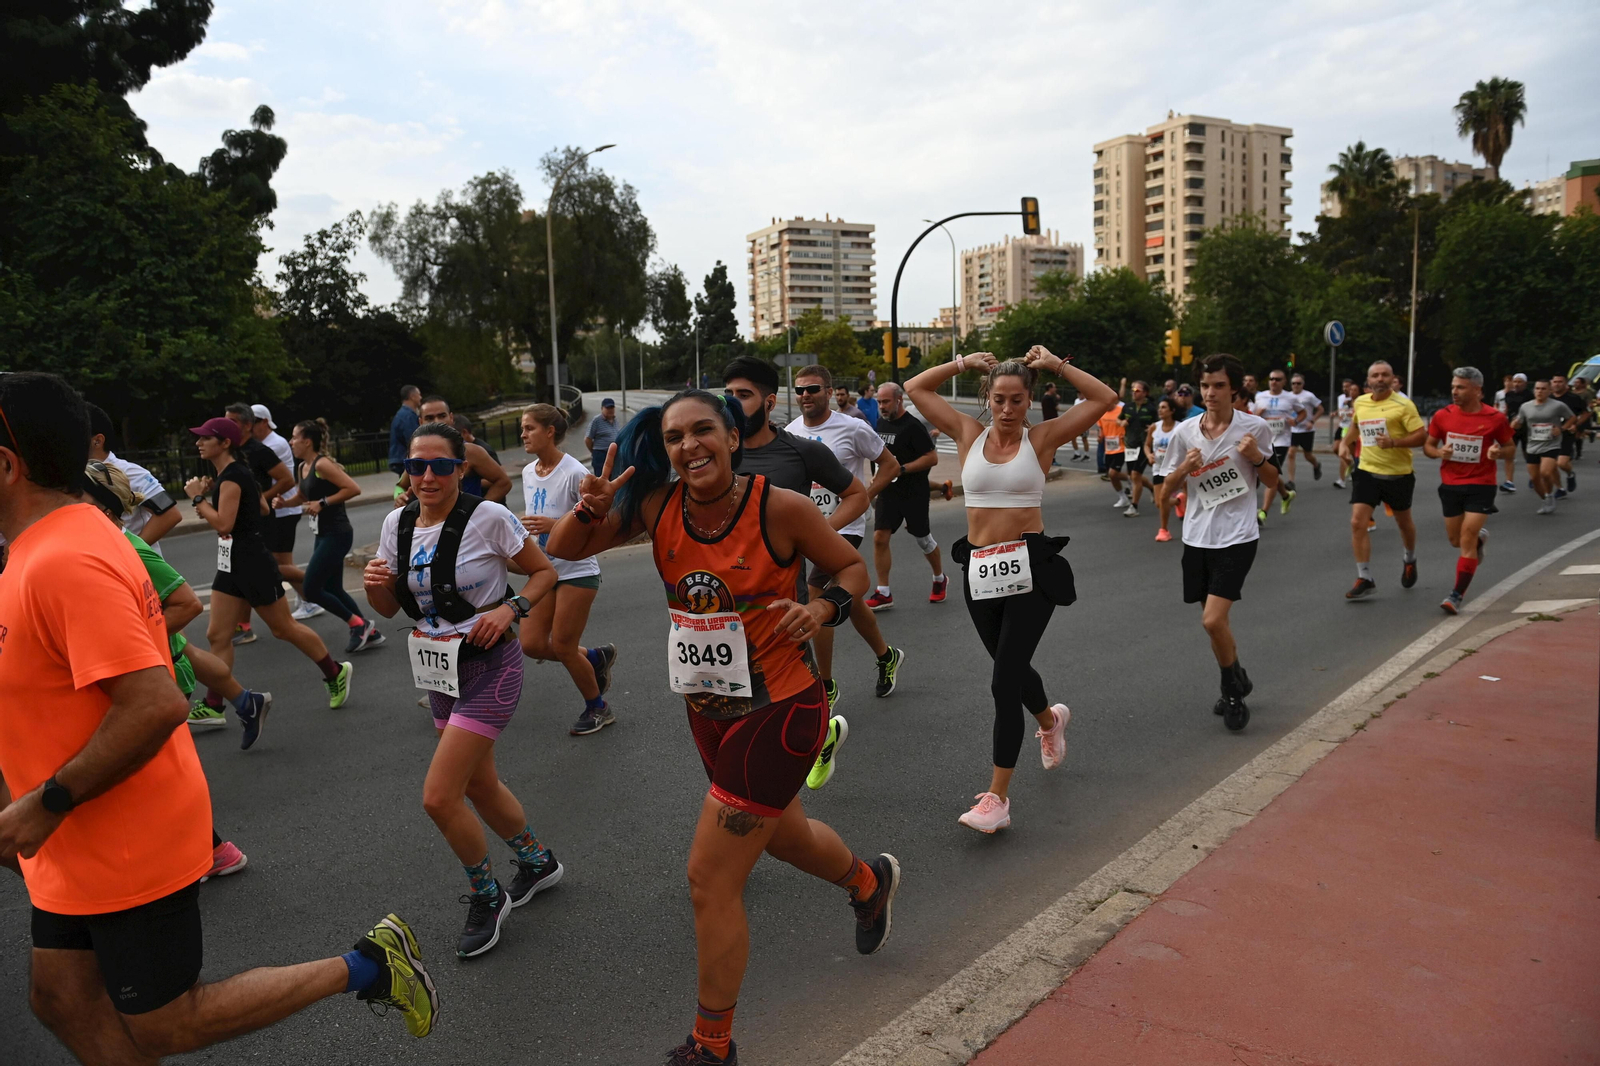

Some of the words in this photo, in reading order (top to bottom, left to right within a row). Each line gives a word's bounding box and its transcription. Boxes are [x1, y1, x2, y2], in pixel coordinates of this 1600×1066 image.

[1199, 468, 1239, 493] 11986
[217, 545, 230, 558] 795
[978, 559, 1021, 579] 9195
[457, 584, 474, 594] ANA
[685, 574, 720, 589] BEER
[694, 622, 726, 632] MALAGA
[707, 615, 741, 625] URBANA
[417, 648, 449, 671] 1775
[677, 641, 733, 667] 3849
